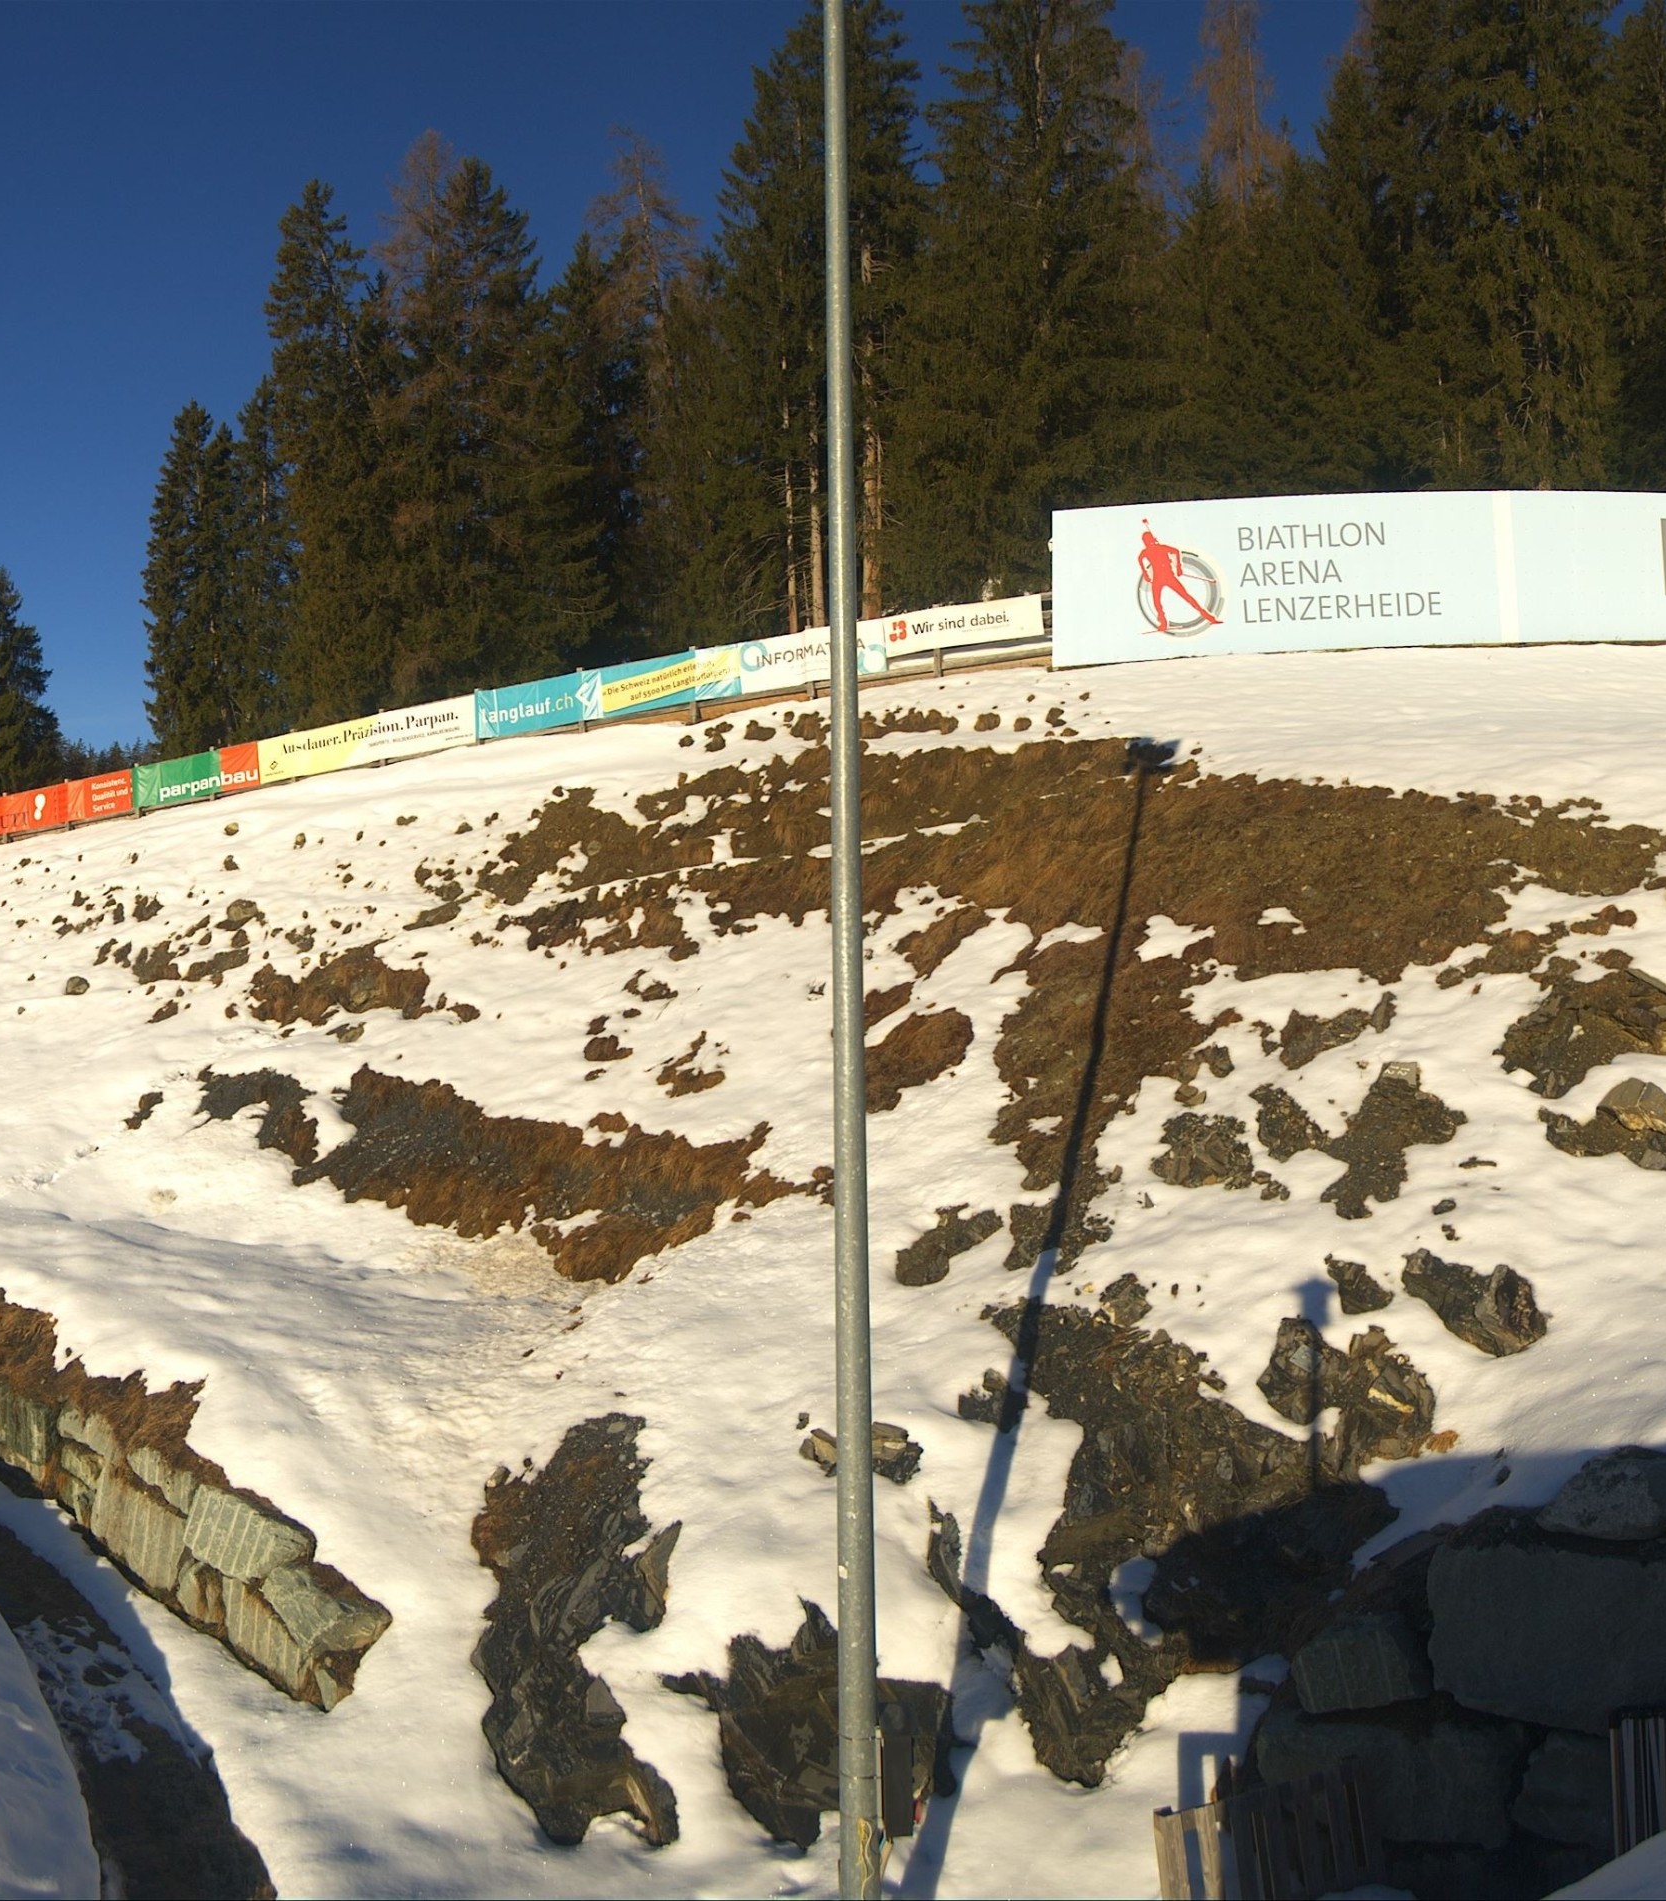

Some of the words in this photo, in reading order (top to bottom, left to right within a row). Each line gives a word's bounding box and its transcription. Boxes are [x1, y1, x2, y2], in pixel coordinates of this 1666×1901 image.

[1236, 521, 1387, 552] BIATHLON
[1239, 558, 1343, 588] ARENA
[1242, 591, 1443, 624] LENZERHEIDE
[911, 622, 935, 636] Wir
[938, 614, 965, 631] sind
[755, 636, 866, 668] INFORMAA
[620, 677, 651, 693] Schweiz
[651, 668, 683, 684] natürlich
[630, 690, 642, 702] auf
[660, 683, 672, 694] km
[480, 693, 575, 726] langlauf.ch
[281, 734, 342, 756] Ausdauer.
[343, 720, 404, 744] Präzision.
[405, 709, 459, 732] Parpan.
[116, 786, 129, 799] und
[159, 768, 259, 803] parpanbau
[92, 802, 116, 814] Service
